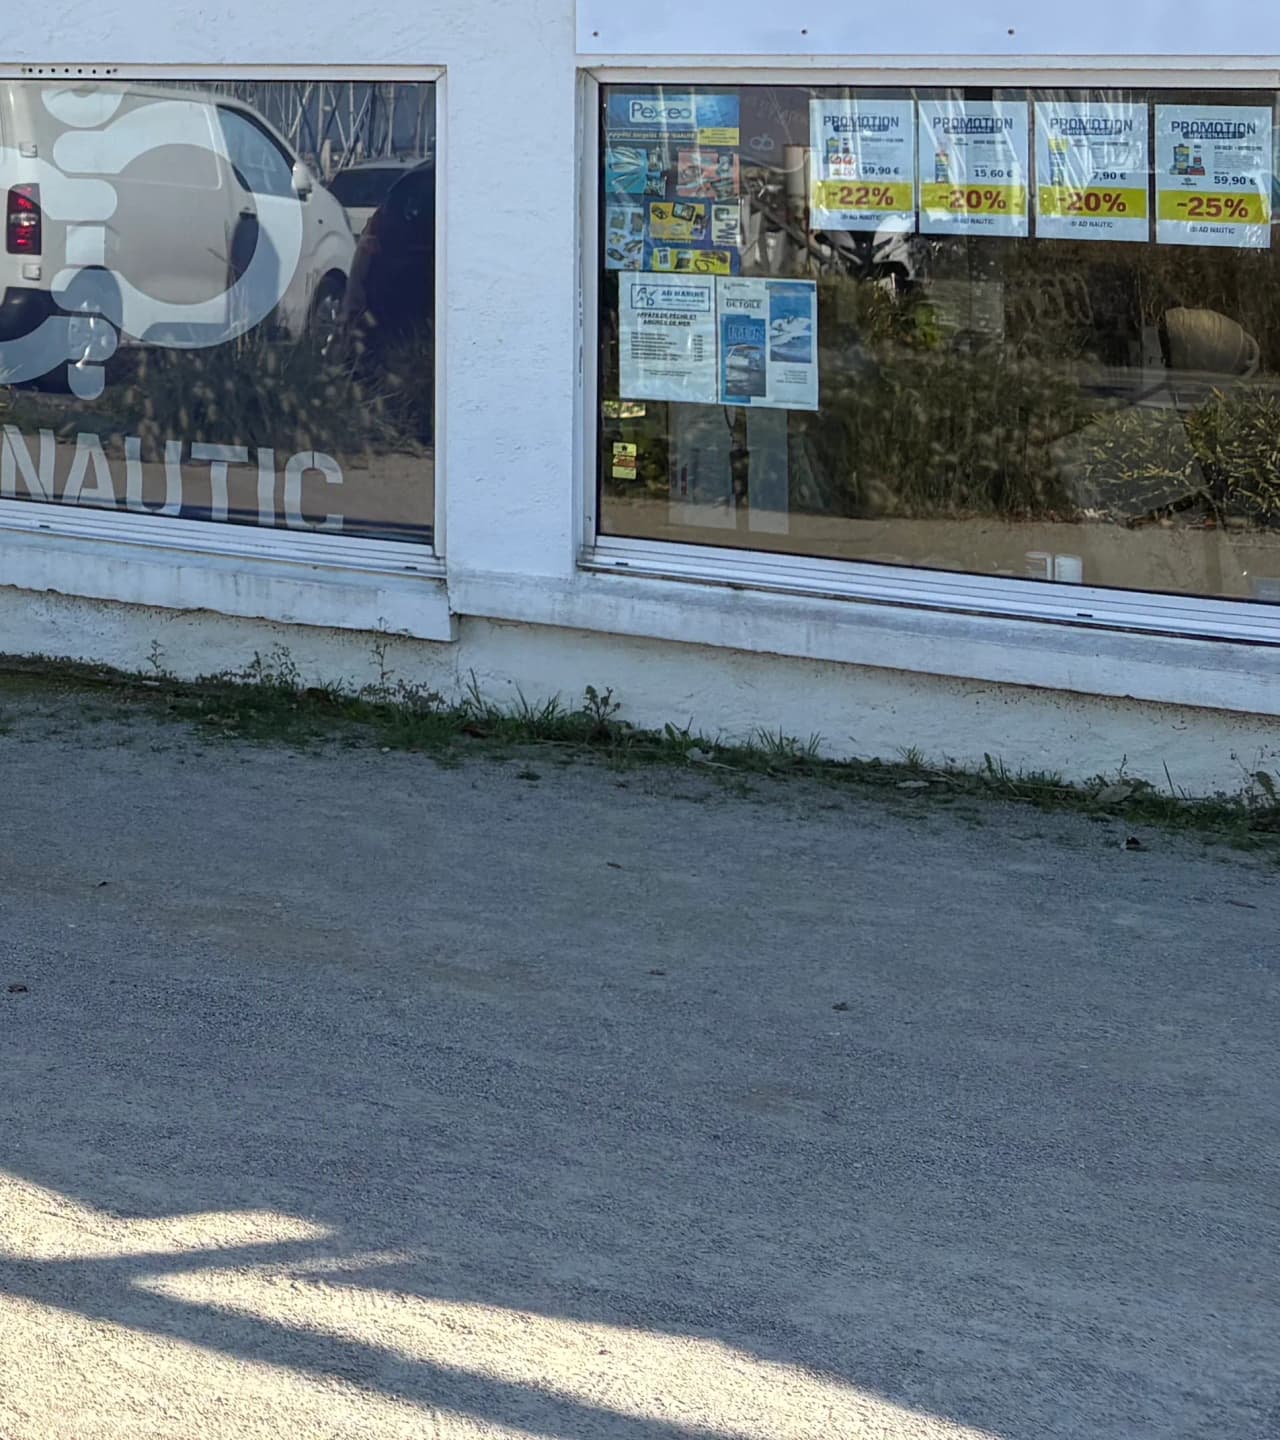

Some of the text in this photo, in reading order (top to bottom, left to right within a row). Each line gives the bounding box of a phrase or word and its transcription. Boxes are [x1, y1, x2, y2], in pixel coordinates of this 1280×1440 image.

[824, 115, 899, 127] PROMOTION
[933, 117, 1013, 130] PROMOTION
[1050, 118, 1132, 132] PROMOTION
[1171, 121, 1256, 134] PROMOTION
[1214, 176, 1246, 186] 59,90
[828, 186, 894, 207] -22%
[1177, 197, 1248, 218] -25%
[0, 423, 344, 531] NAUTIC
